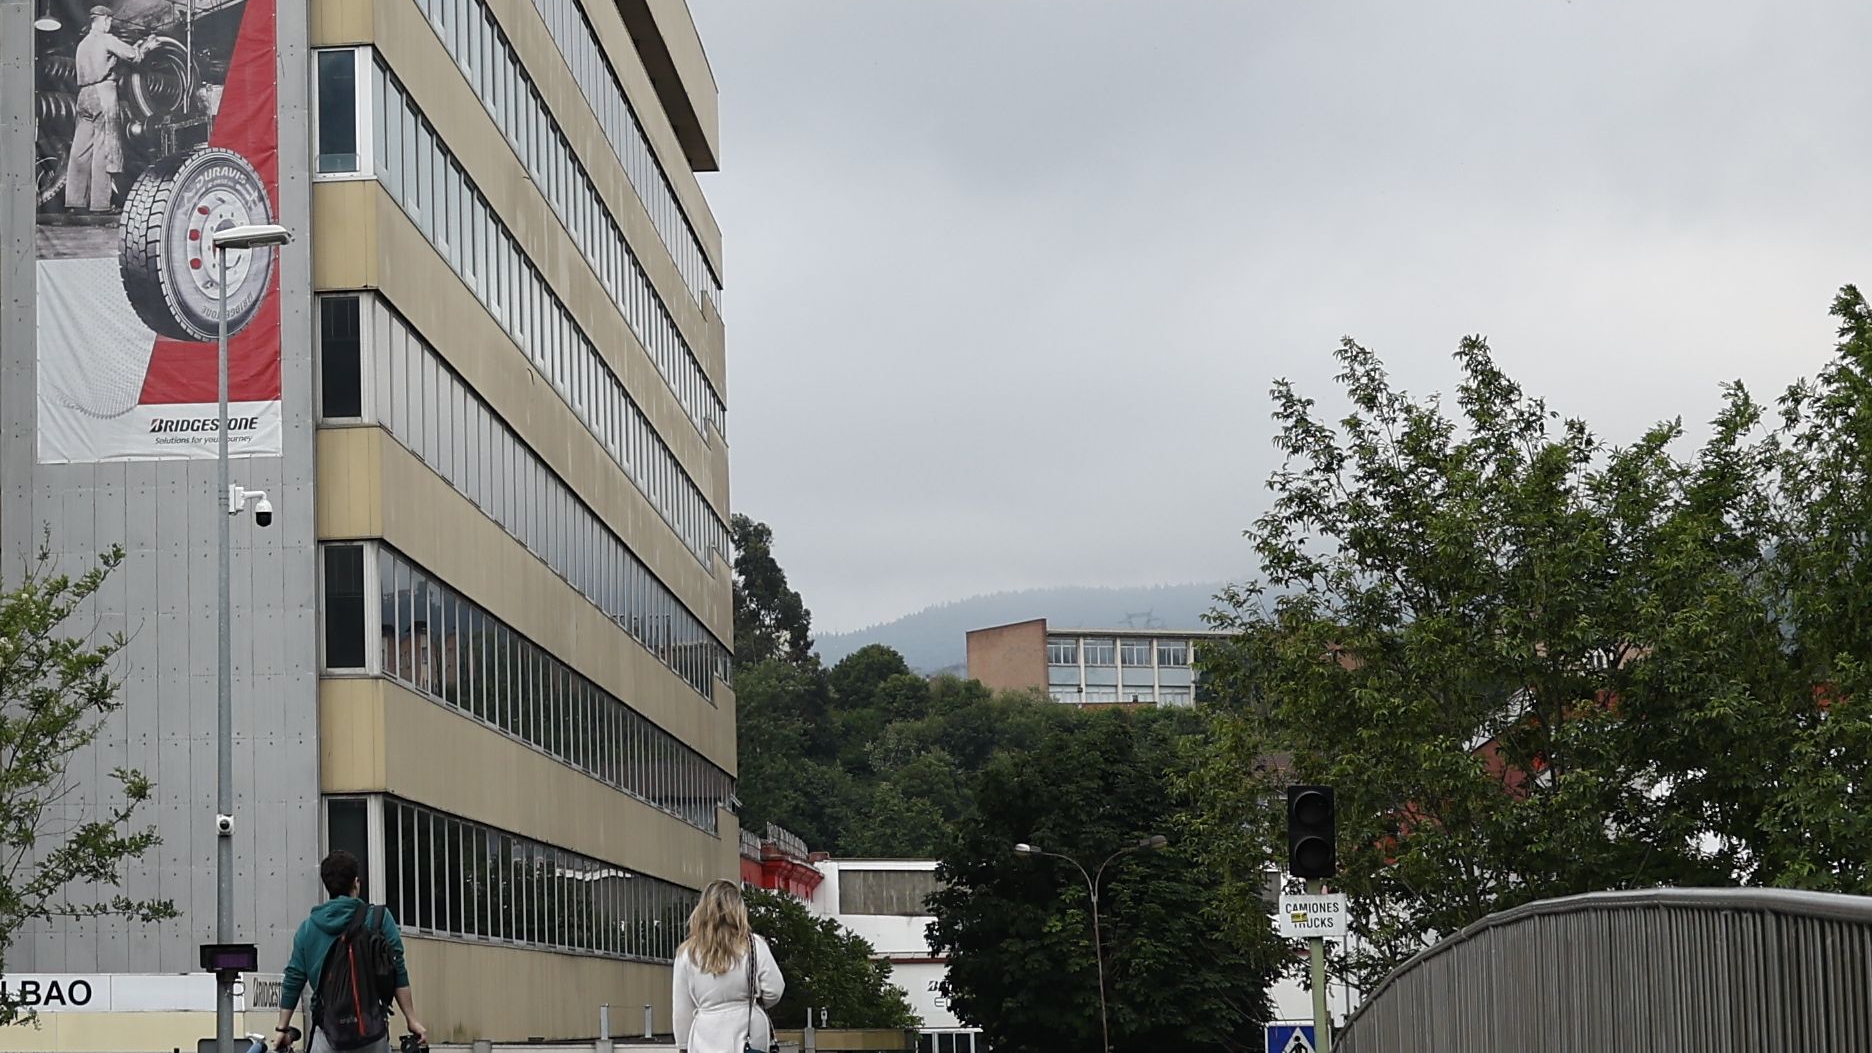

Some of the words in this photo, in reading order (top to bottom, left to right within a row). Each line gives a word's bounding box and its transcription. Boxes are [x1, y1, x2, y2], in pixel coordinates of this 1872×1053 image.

[195, 166, 248, 189] DURAVIS
[149, 417, 258, 433] BRIDGESONE
[155, 436, 189, 444] Solutions
[191, 436, 203, 444] for
[227, 435, 252, 444] ourney
[1285, 902, 1339, 913] CAMIONES
